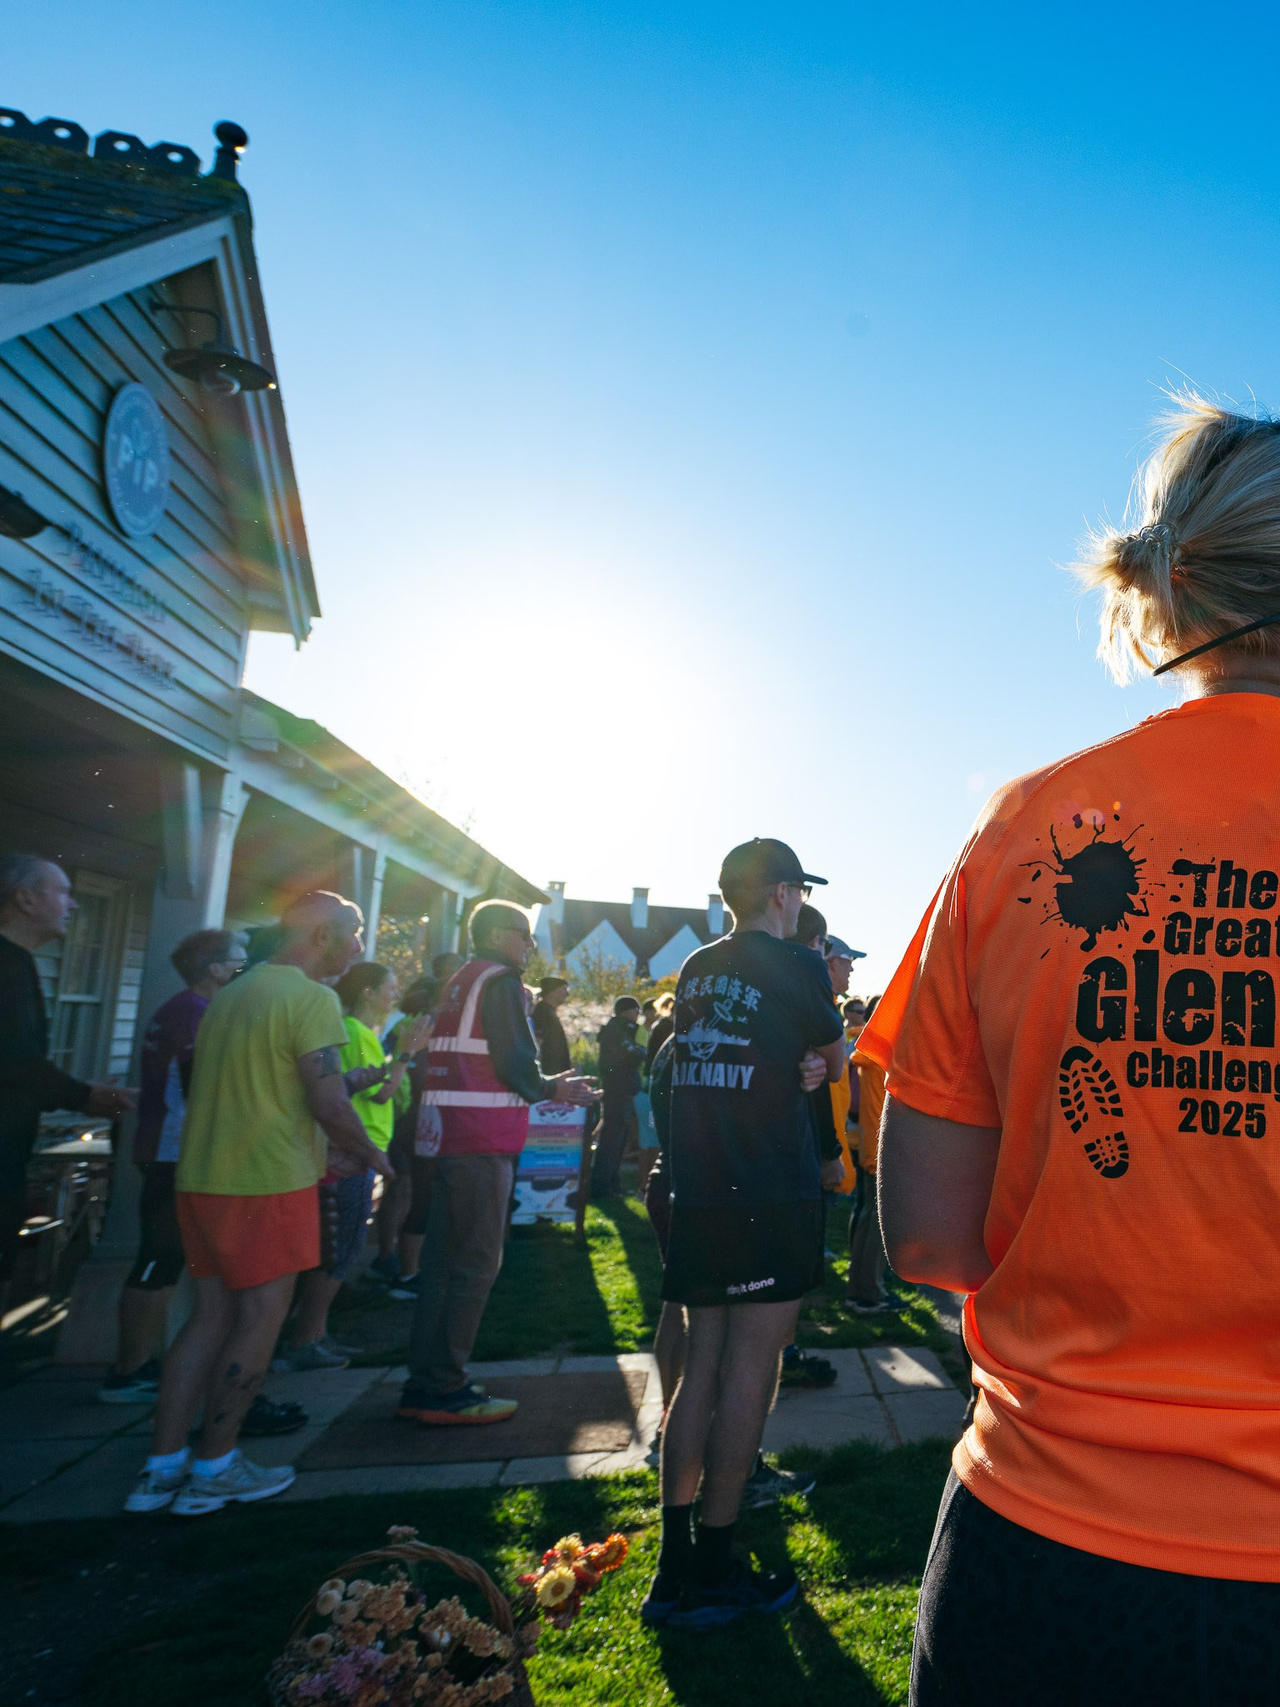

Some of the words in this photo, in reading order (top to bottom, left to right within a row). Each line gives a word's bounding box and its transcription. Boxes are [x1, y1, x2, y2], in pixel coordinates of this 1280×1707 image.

[1185, 859, 1280, 910] The
[1178, 1097, 1267, 1139] 2025
[747, 1277, 775, 1291] done
